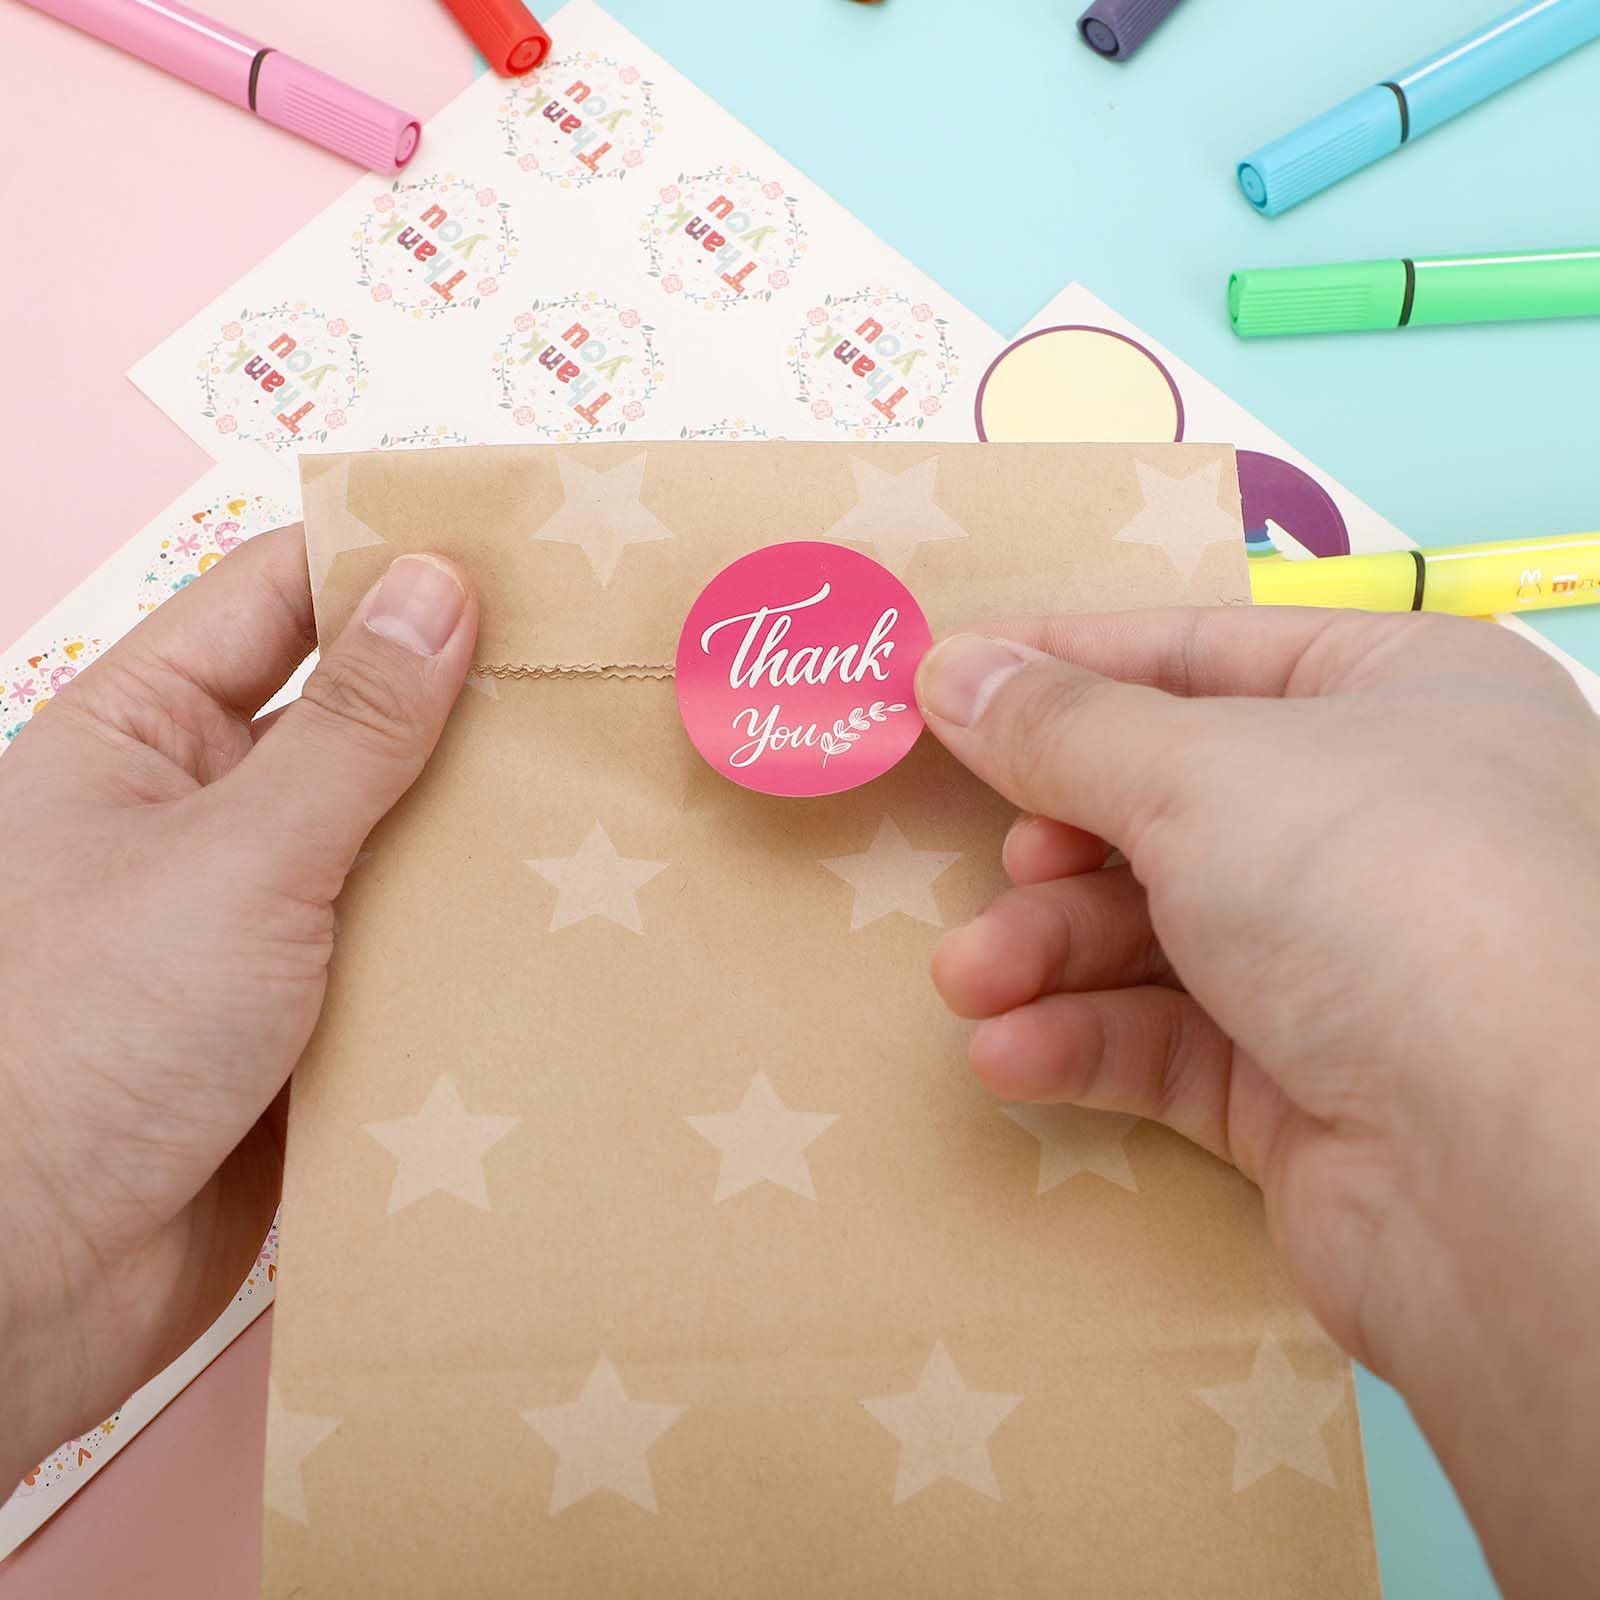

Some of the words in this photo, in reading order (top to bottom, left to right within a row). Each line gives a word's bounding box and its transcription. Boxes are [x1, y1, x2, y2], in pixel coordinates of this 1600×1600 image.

[524, 87, 613, 172] Thank
[564, 79, 632, 133] you
[377, 211, 467, 302] Thank
[419, 203, 489, 260] you
[663, 202, 758, 294] Thank
[706, 194, 776, 252] you
[267, 332, 338, 391] you
[518, 329, 612, 426] Thank
[561, 322, 632, 383] you
[813, 324, 909, 420] Thank
[855, 317, 928, 376] you
[224, 340, 315, 434] Thank
[700, 582, 899, 689] Thank
[729, 704, 821, 768] You
